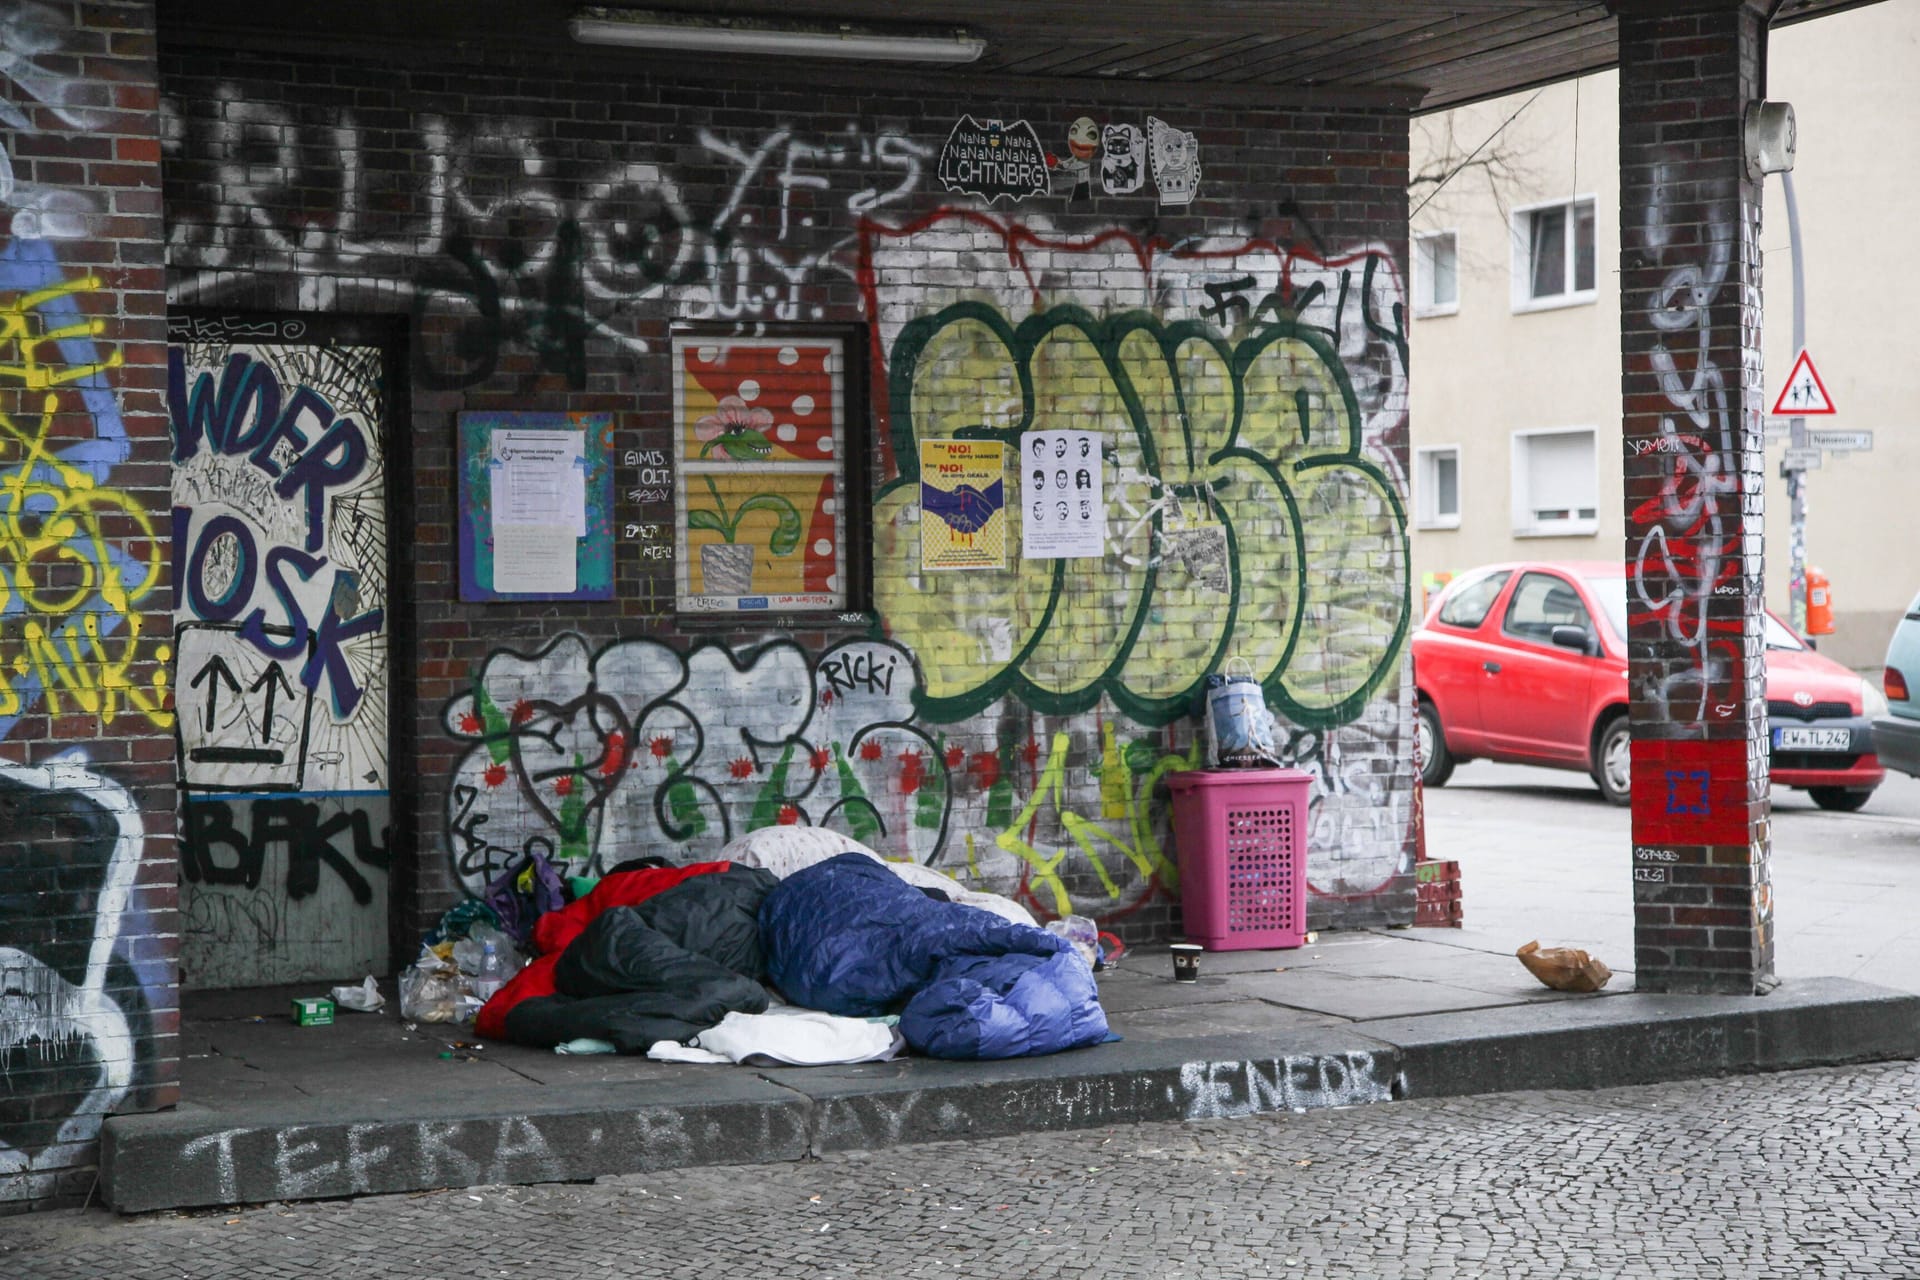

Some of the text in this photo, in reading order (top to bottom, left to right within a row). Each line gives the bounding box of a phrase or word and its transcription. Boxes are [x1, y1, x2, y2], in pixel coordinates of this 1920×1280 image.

[946, 159, 1044, 187] LCHTNBRG
[947, 445, 971, 454] NO!
[939, 464, 963, 473] NO!
[1783, 731, 1849, 745] EW TL 242
